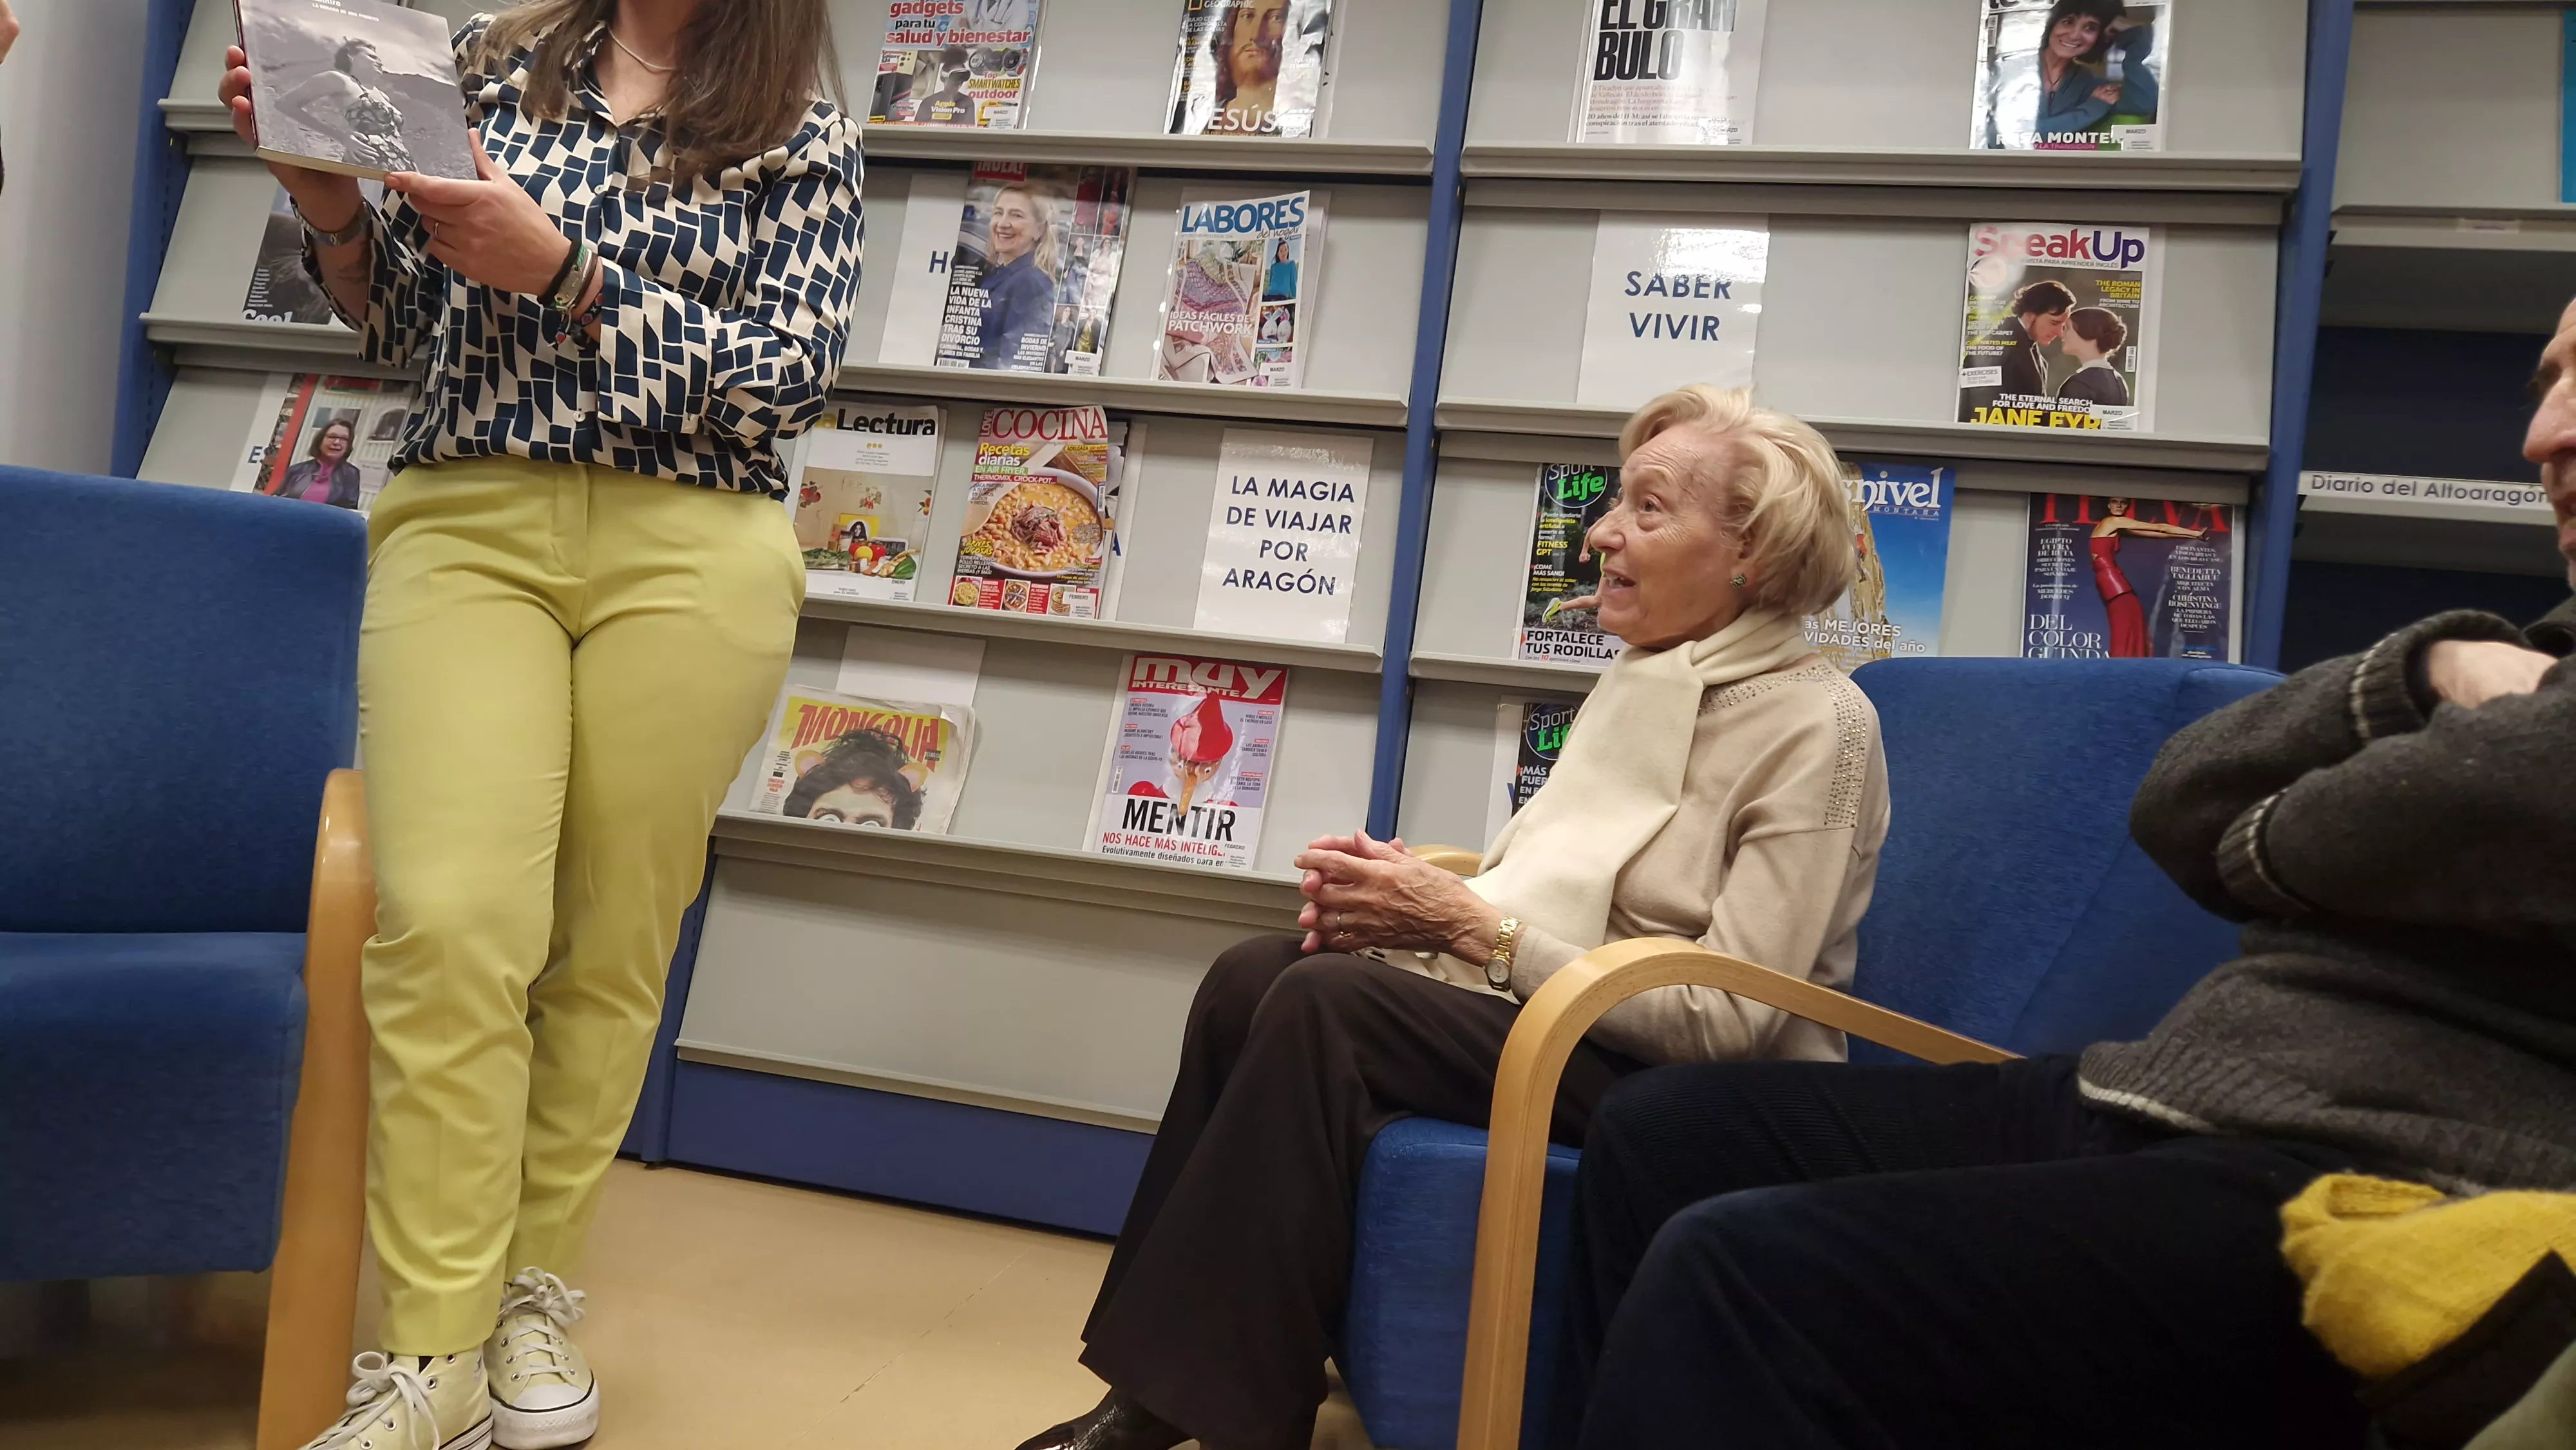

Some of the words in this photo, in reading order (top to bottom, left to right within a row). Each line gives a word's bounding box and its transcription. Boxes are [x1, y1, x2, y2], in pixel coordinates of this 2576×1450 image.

[890, 1, 964, 17] gadgets
[1643, 0, 1736, 32] GRAN
[895, 18, 922, 30] para
[924, 19, 936, 28] tu
[886, 30, 933, 44] salud
[936, 33, 946, 46] y
[948, 29, 1030, 44] bienestar
[1593, 30, 1685, 80] BULO
[969, 79, 1021, 89] SMARTWATCHES
[968, 89, 1018, 99] outdoor
[1208, 105, 1277, 133] ESÚS
[1996, 131, 2043, 145] RSA
[1181, 197, 1305, 234] LABORES
[1256, 228, 1271, 240] del
[1273, 226, 1300, 240] hogar
[950, 286, 960, 295] LA
[961, 287, 989, 298] NUEVA
[1624, 270, 1732, 300] SABER
[947, 305, 980, 317] INFANTA
[949, 296, 967, 306] VIDA
[969, 297, 980, 306] DE
[981, 298, 992, 309] LA
[945, 314, 982, 326] CRISTINA
[1170, 311, 1197, 320] IDEAS
[1198, 310, 1235, 323] FÁCILES
[1236, 313, 1250, 323] DE
[943, 324, 965, 335] TRAS
[965, 326, 978, 336] SU
[1168, 319, 1254, 335] PATCHWORK
[1629, 312, 1720, 341] VIVIR
[941, 333, 981, 346] DIVORCIO
[1992, 399, 2011, 408] FOR
[2012, 401, 2036, 410] LOVE
[2036, 402, 2056, 411] AND
[2057, 405, 2090, 413] FREEDO
[2000, 393, 2017, 401] THE
[2018, 394, 2058, 404] ETERNAL
[2058, 397, 2093, 407] SEARCH
[836, 408, 936, 436] Lectura
[981, 409, 994, 437] LOVE
[992, 408, 1108, 441] COCINA
[1970, 407, 2043, 428] JANE
[2049, 411, 2101, 429] EYR
[979, 442, 1030, 457] Recetas
[978, 453, 1021, 466] diarias
[1000, 467, 1027, 476] FRYER,
[1231, 475, 1259, 496] LA
[1266, 478, 1355, 503] MAGIA
[1556, 472, 1605, 502] Life
[2311, 474, 2374, 494] Diario
[2382, 480, 2416, 497] del
[1226, 505, 1256, 527] DE
[1265, 509, 1352, 534] VIAJAR
[1259, 540, 1309, 562] POR
[1537, 540, 1569, 549] FITNESS
[2170, 565, 2221, 575] BENEDETTA
[1221, 568, 1336, 596] ARAGÓN
[1805, 621, 1819, 630] as
[1824, 619, 1902, 637] MEJORES
[2030, 614, 2073, 631] DEL
[1526, 630, 1605, 646] FORTALECE
[1874, 638, 1896, 650] del
[1899, 641, 1926, 653] año
[2029, 630, 2102, 649] COLOR
[1526, 643, 1551, 654] TUS
[1133, 657, 1282, 700] muy
[1131, 680, 1240, 698] INTERESANTE
[1530, 709, 1575, 730] Sport
[790, 703, 942, 773] MONGOLIA
[1537, 724, 1573, 753] Lif
[1520, 764, 1547, 777] ¡MÁS
[1121, 798, 1236, 842] MENTIR
[1103, 832, 1122, 844] NOS
[1124, 834, 1151, 848] HACE
[1155, 836, 1177, 851] MÁS
[1180, 842, 1226, 858] INTELIG
[1102, 845, 1155, 860] Evolutivamente
[1157, 852, 1195, 865] diseñados
